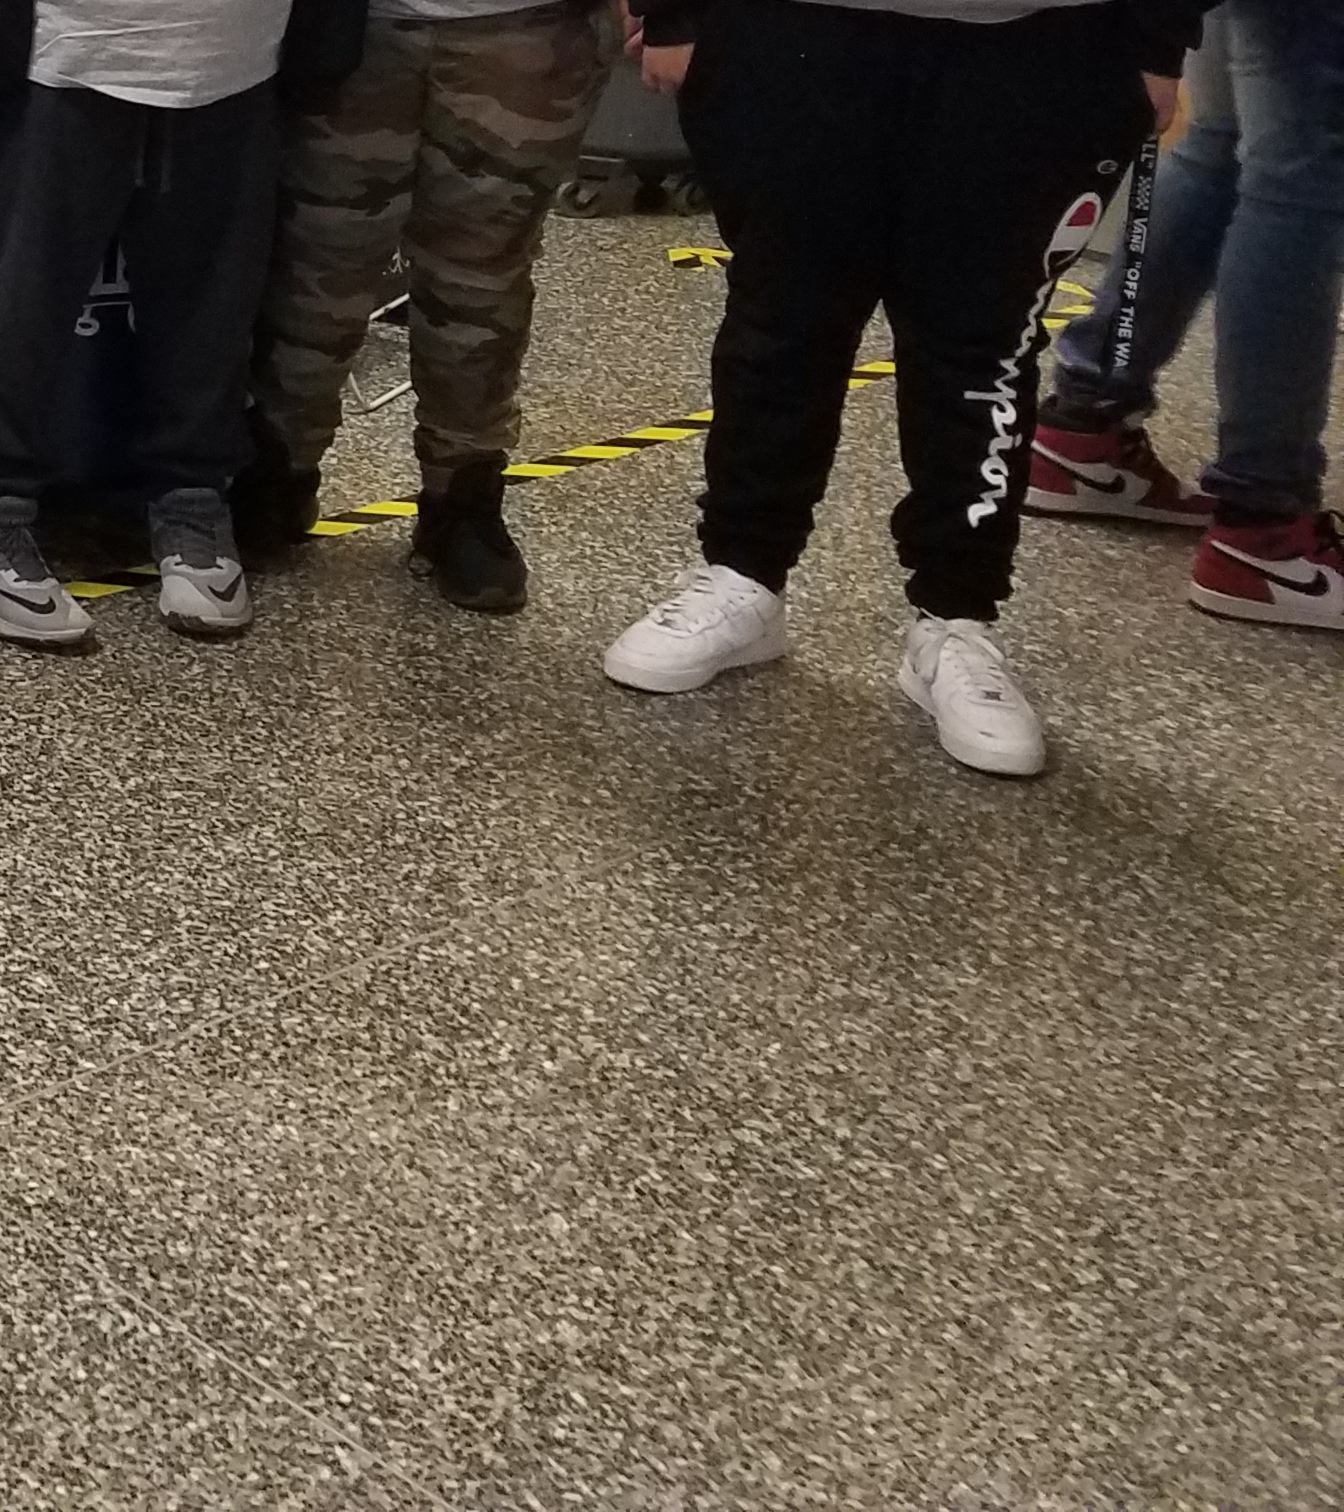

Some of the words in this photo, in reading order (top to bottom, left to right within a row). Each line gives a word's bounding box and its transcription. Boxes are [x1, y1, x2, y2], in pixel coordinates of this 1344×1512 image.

[1130, 217, 1149, 254] VANS
[1118, 306, 1135, 339] THE
[1113, 342, 1131, 369] WA
